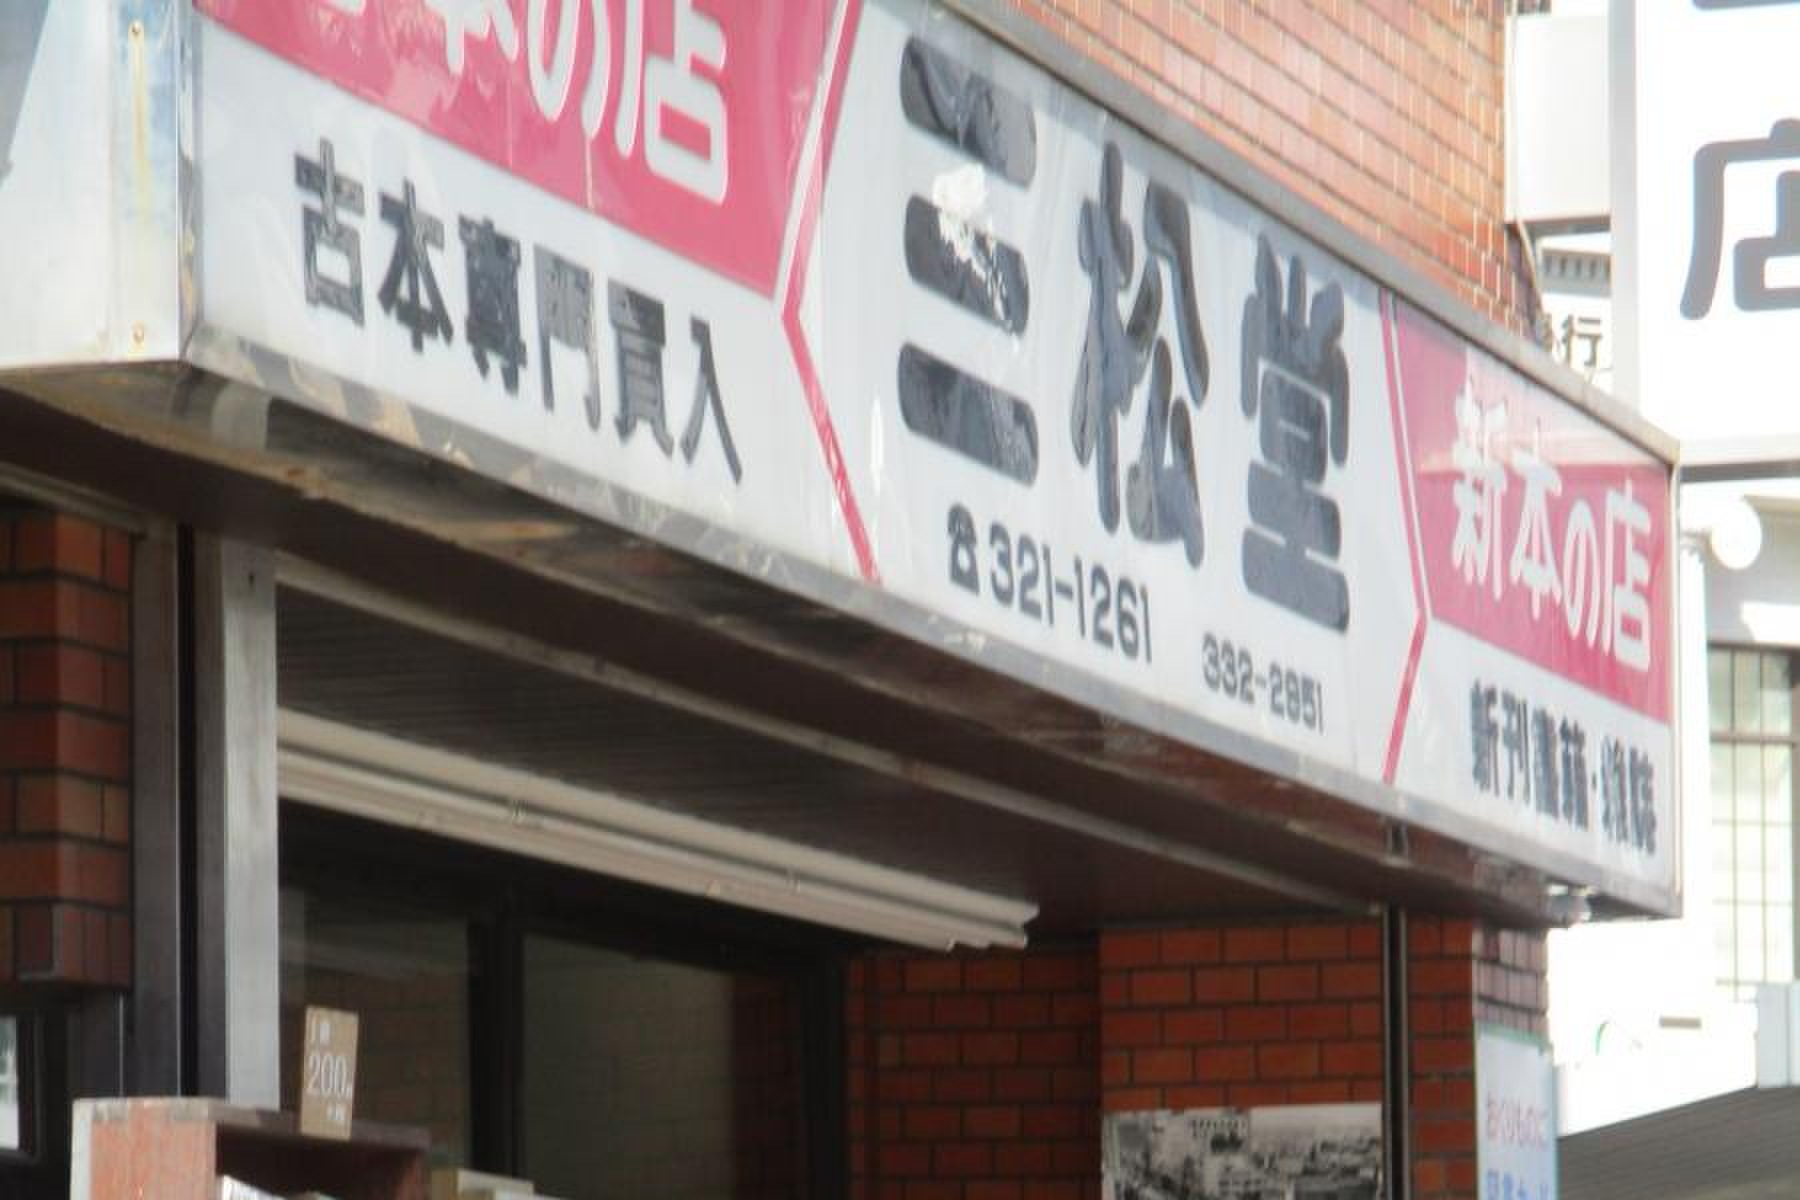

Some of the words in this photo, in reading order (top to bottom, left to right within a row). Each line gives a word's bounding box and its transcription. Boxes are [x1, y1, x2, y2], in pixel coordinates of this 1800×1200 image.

[898, 35, 1351, 634] 三松堂
[989, 540, 1154, 664] 321-1261
[1452, 374, 1653, 674] 新本の店
